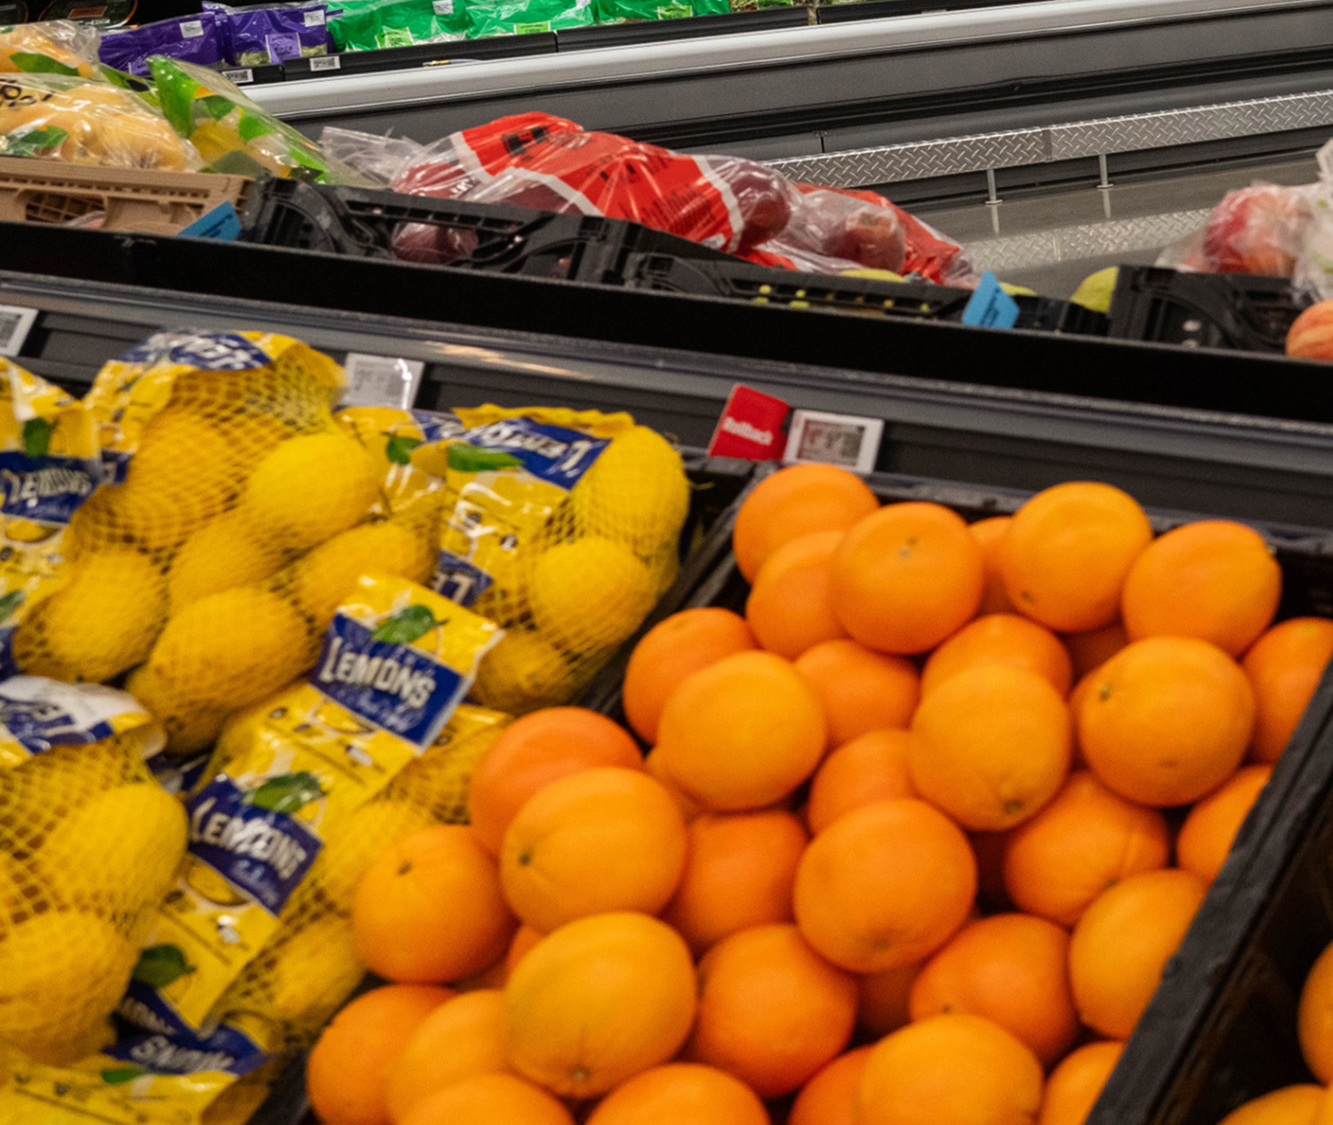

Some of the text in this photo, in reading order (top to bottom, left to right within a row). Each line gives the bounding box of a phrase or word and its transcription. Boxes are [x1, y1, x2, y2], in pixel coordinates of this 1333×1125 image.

[722, 416, 775, 447] Rollback
[319, 636, 437, 709] LEMONS
[190, 796, 308, 881] LEMONS
